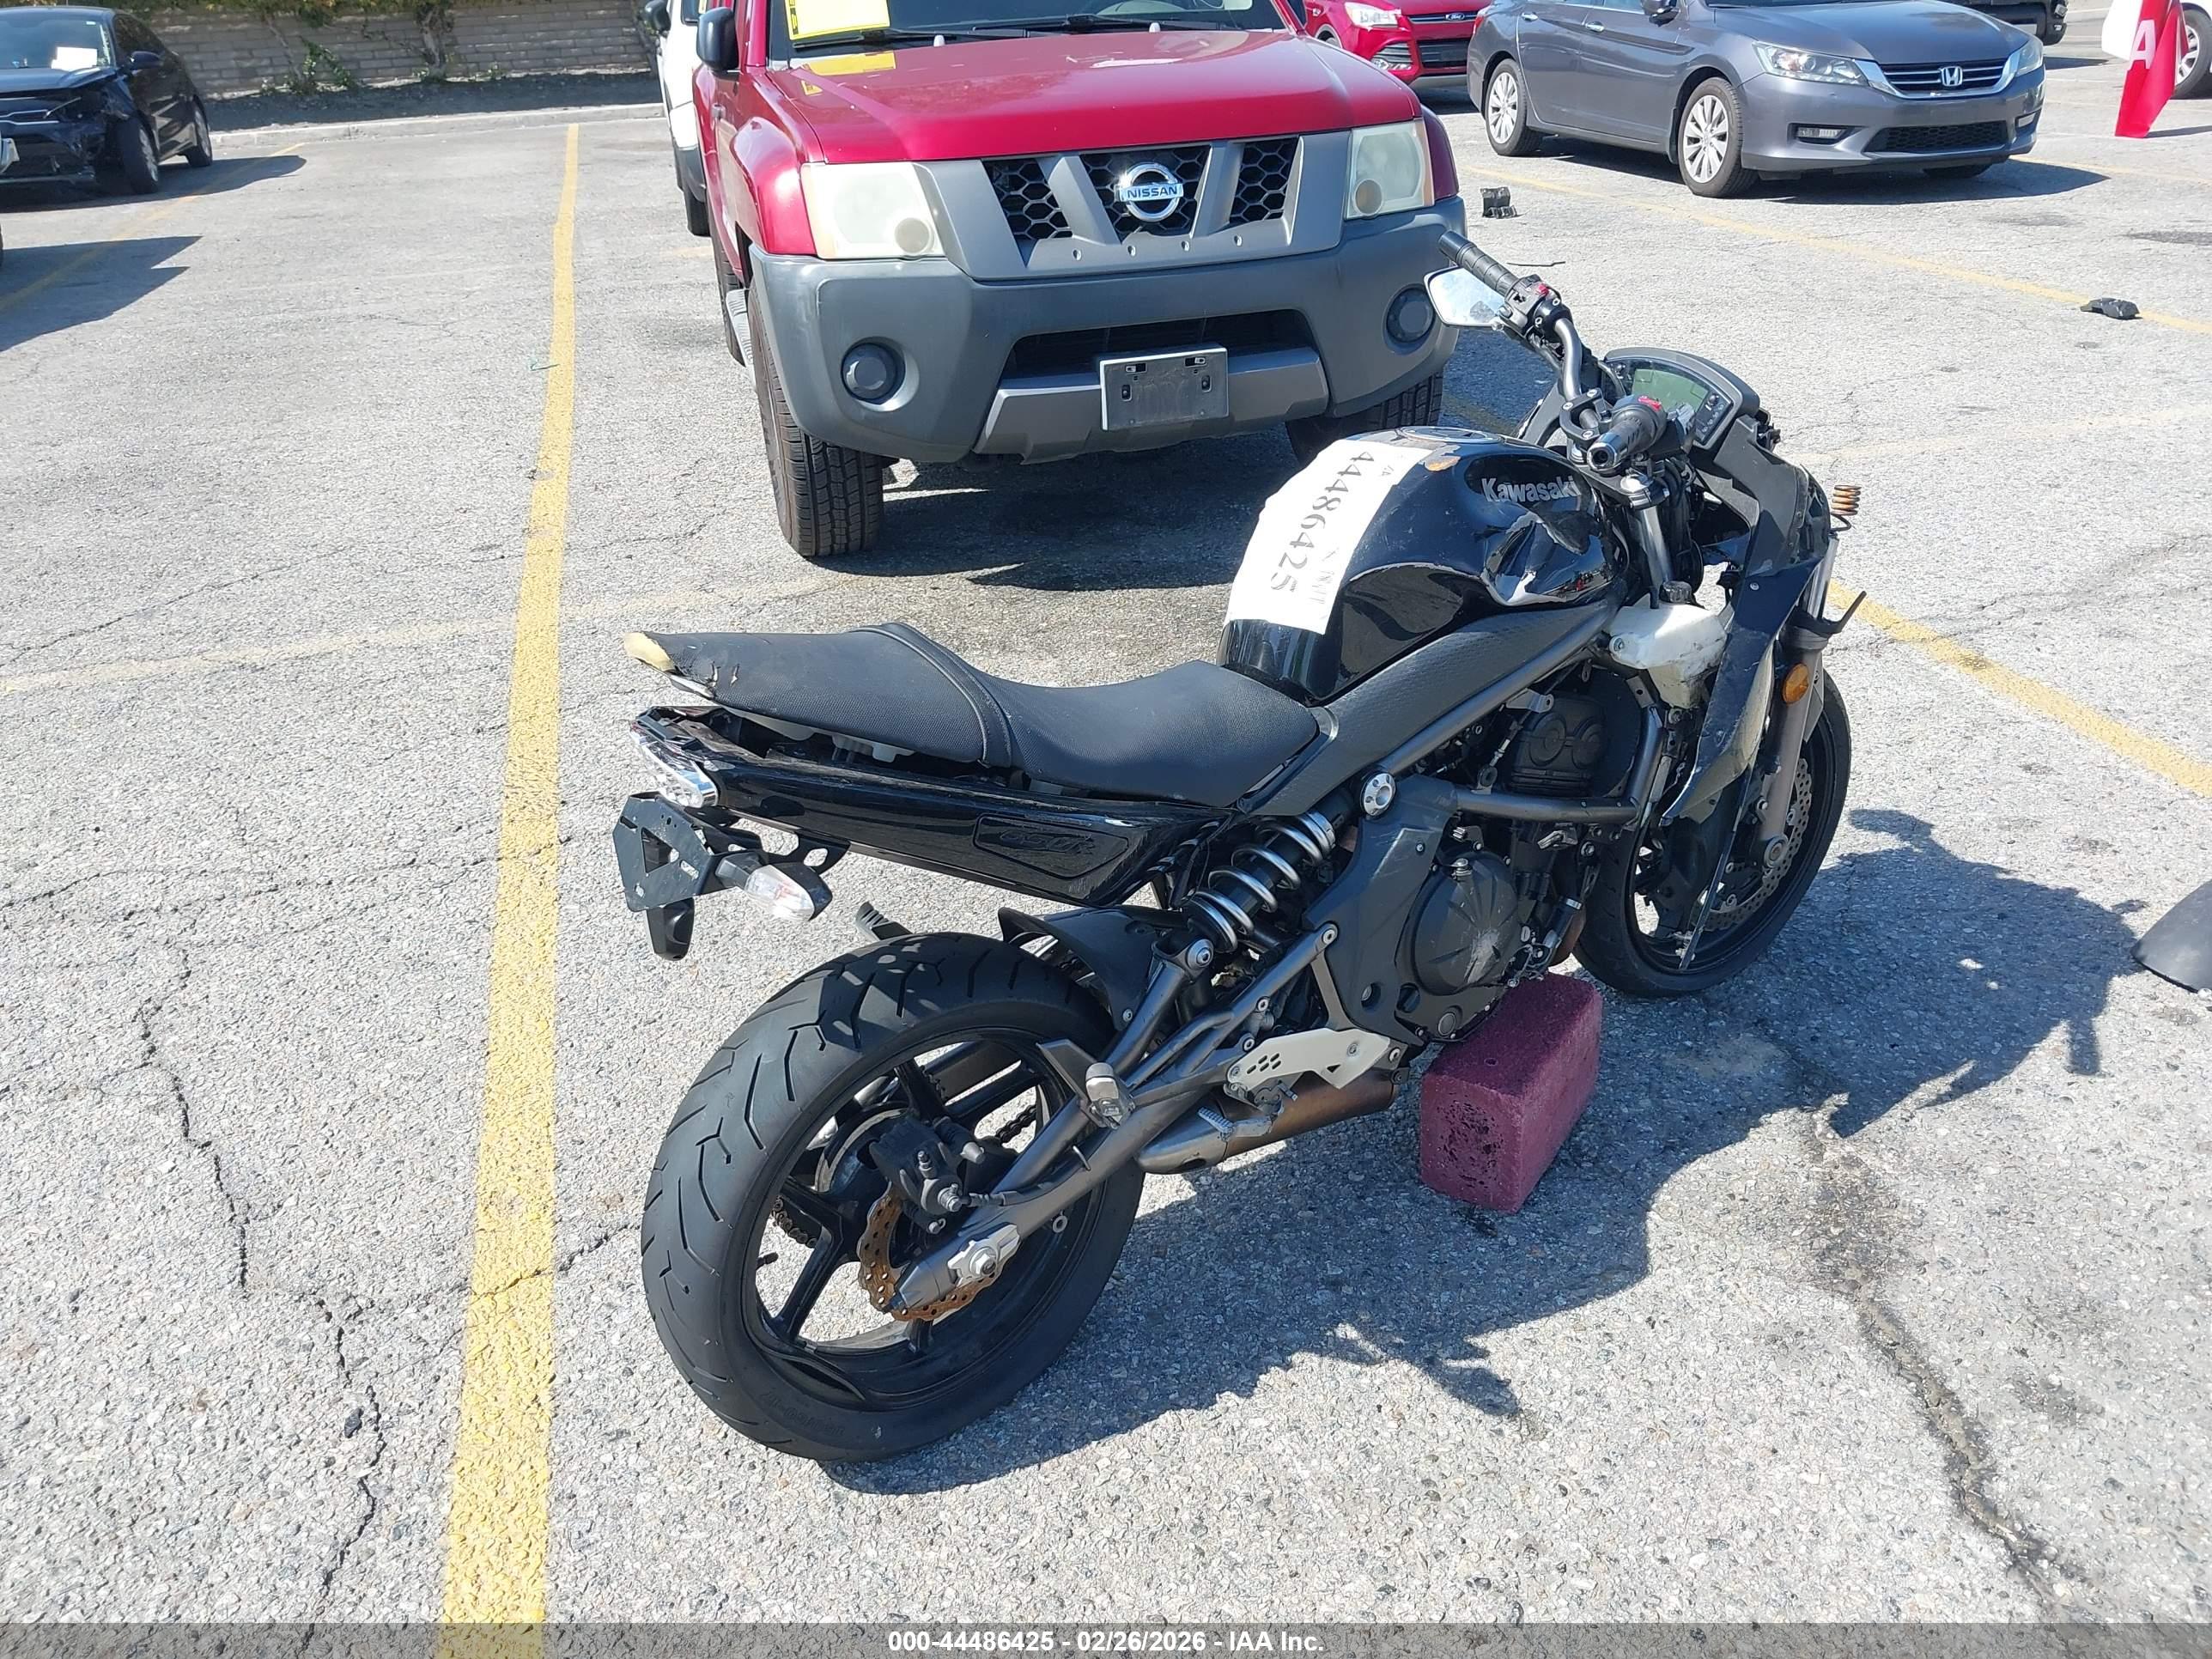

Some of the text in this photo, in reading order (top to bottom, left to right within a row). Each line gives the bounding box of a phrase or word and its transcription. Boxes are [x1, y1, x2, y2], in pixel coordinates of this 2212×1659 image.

[1127, 185, 1177, 198] NISSAN
[1481, 476, 1581, 502] Kawasaki
[1270, 452, 1376, 592] 44486425
